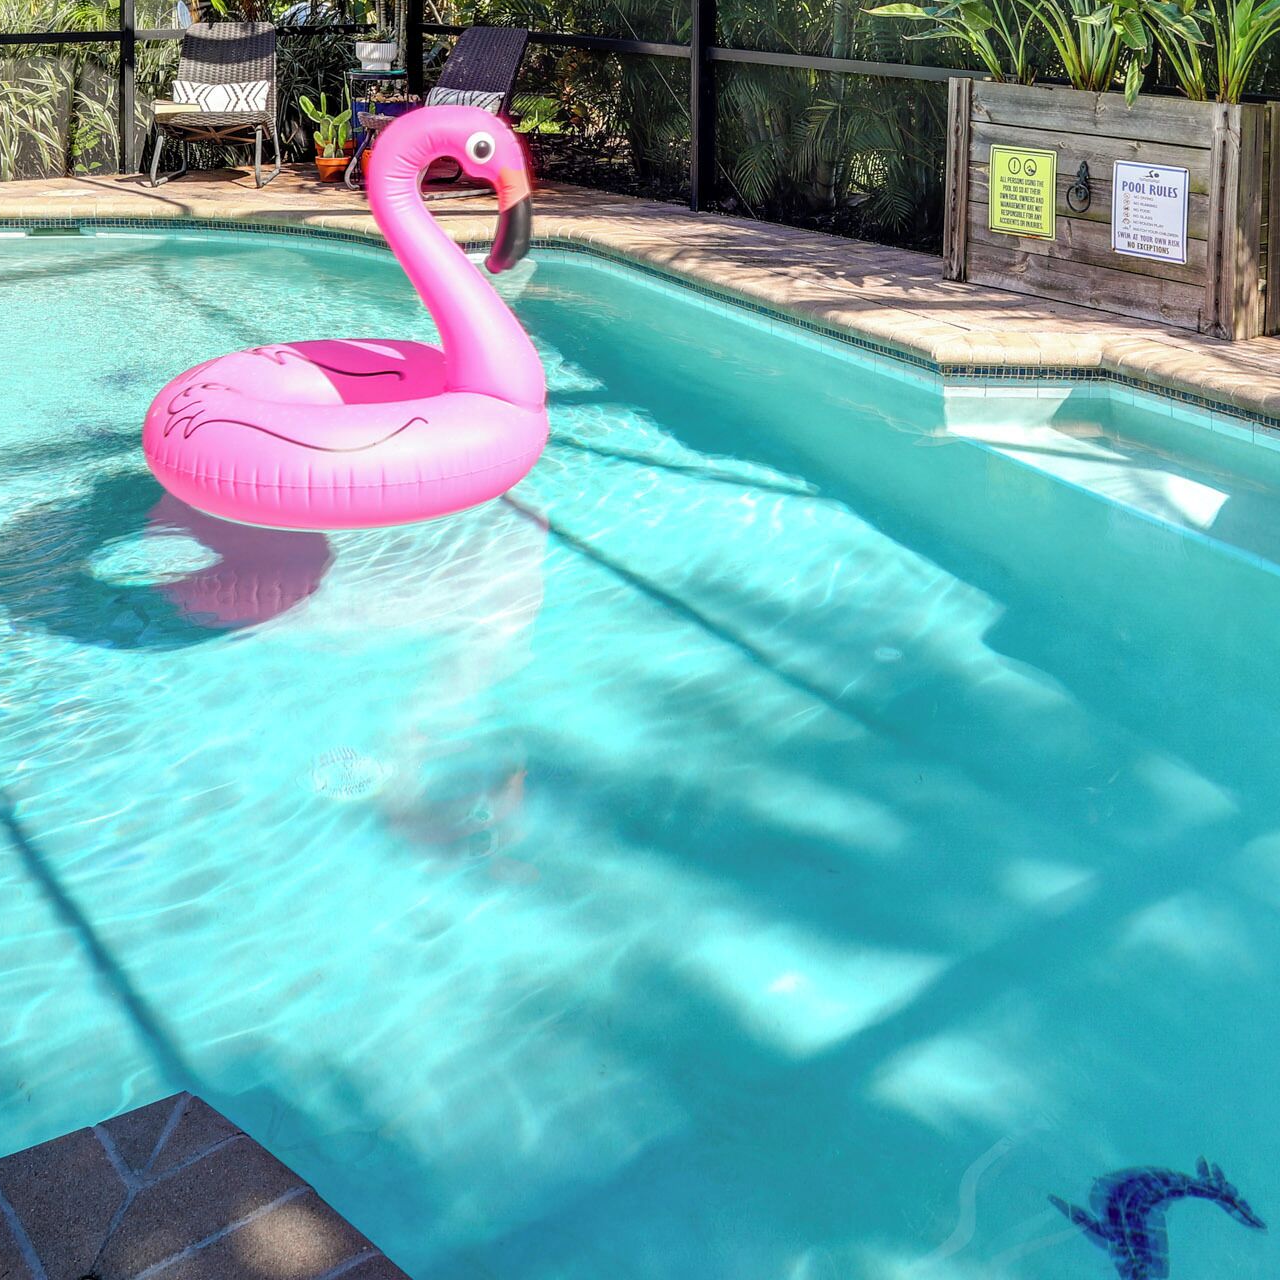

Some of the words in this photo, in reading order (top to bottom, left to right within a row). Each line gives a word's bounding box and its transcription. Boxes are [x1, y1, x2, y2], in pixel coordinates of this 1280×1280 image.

[1007, 177, 1024, 185] PERSONS
[1122, 181, 1146, 194] POOL
[1149, 184, 1178, 198] RULES
[1019, 195, 1035, 203] OWNERS
[1000, 201, 1026, 210] MANAGEMENT
[1001, 209, 1025, 218] RESPONSIBLE
[1000, 217, 1019, 225] ACCIDENTS
[1117, 231, 1131, 239] SWIM
[1141, 235, 1153, 243] YOUR
[1154, 237, 1167, 245] OWN
[1137, 243, 1170, 255] EXCEPTIONS
